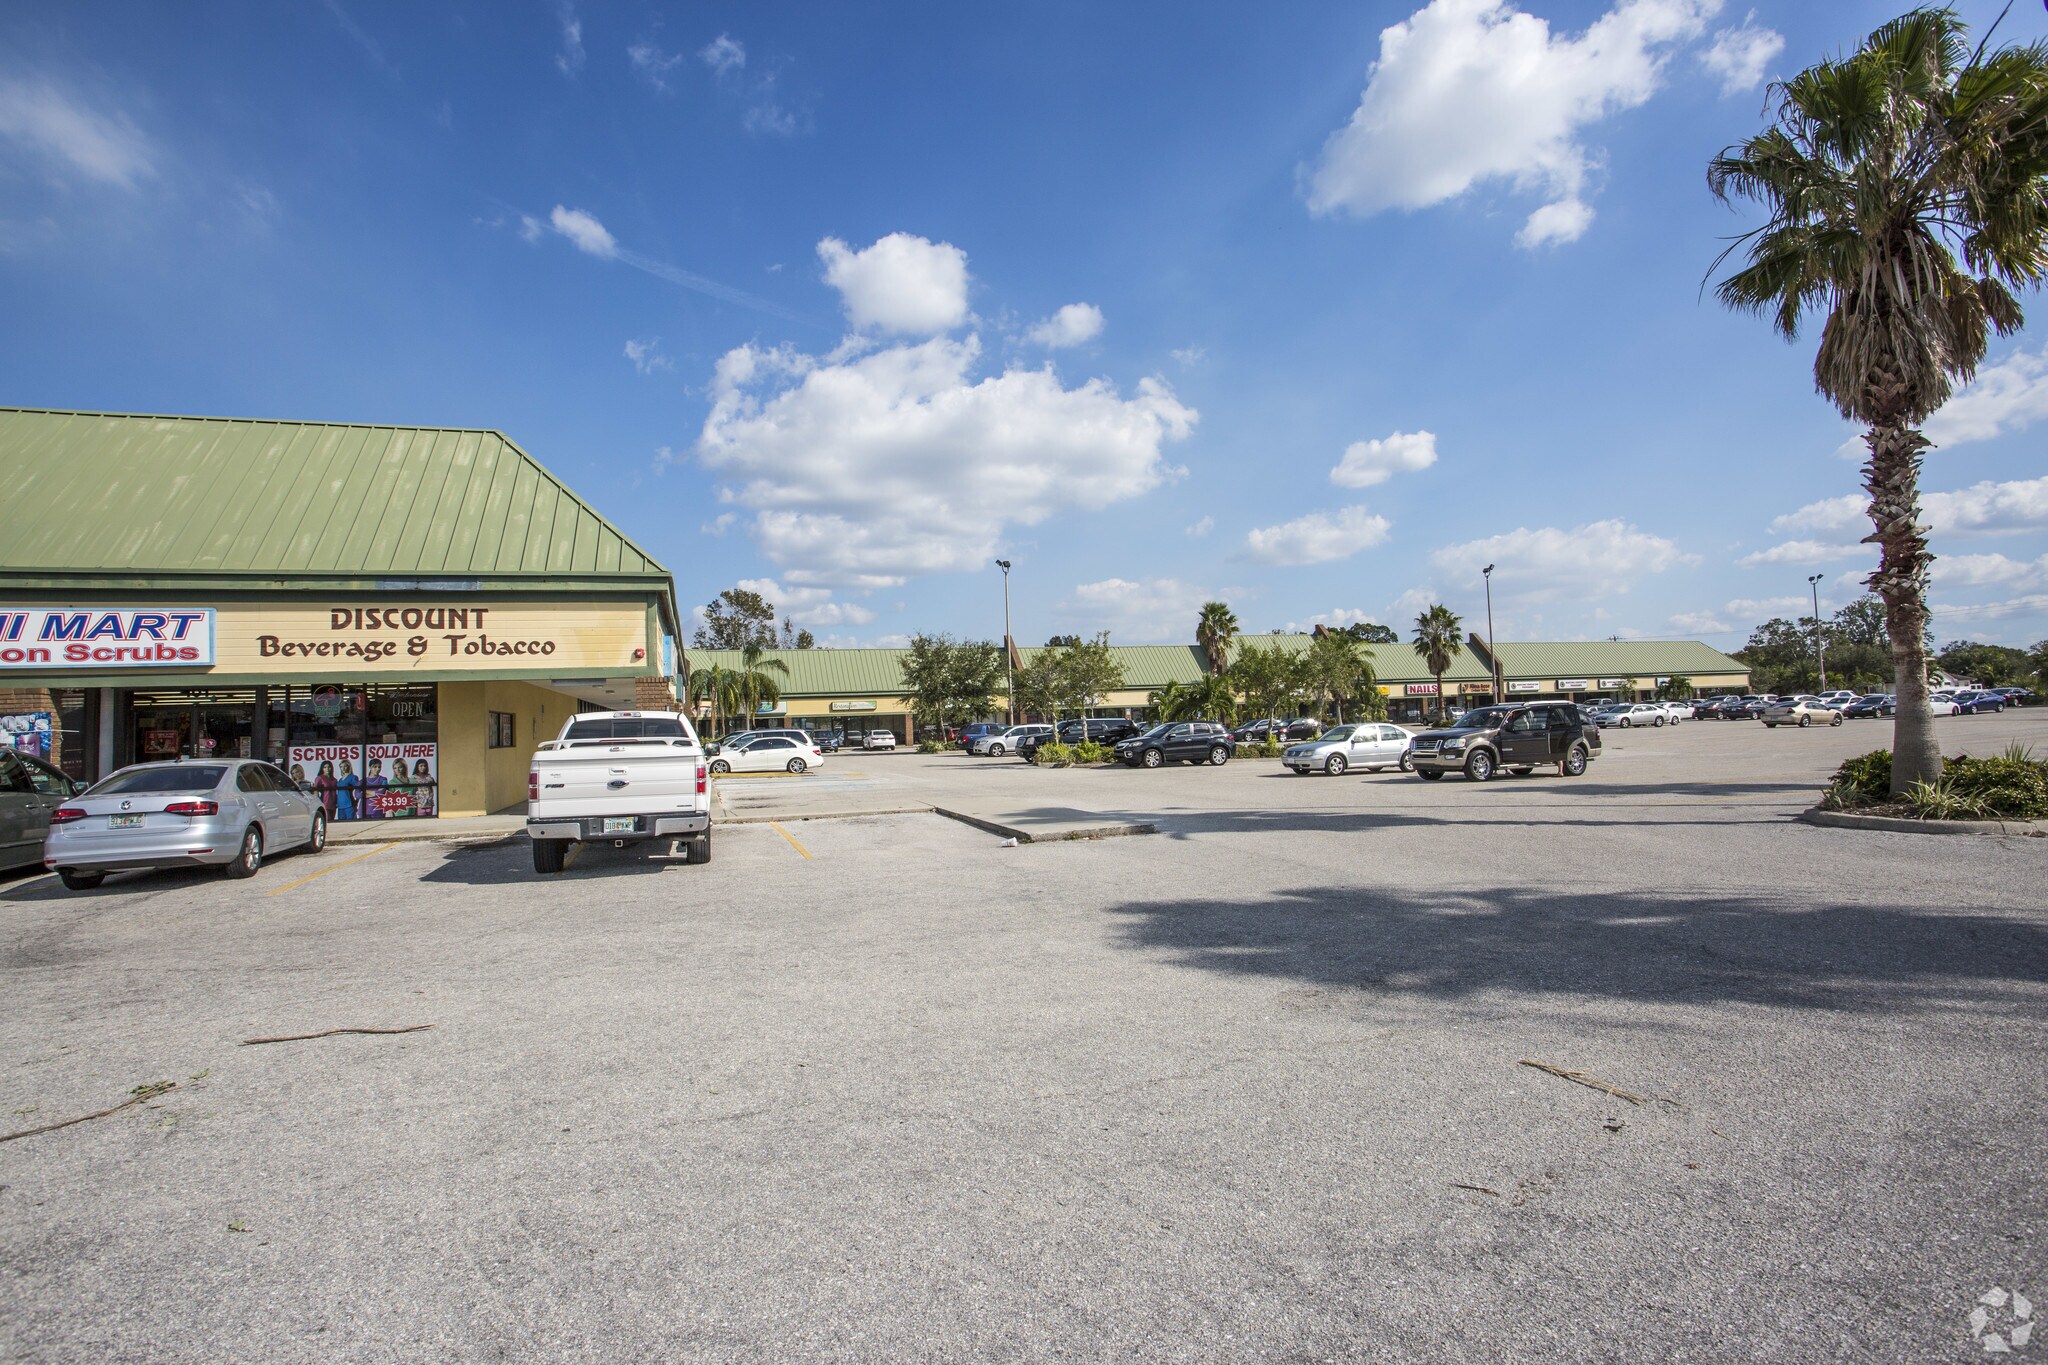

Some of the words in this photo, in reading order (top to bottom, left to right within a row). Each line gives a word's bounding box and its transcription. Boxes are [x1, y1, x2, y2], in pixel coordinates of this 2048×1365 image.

[37, 612, 205, 641] MART
[330, 608, 489, 630] DISCOUNT
[63, 643, 200, 662] Scrubs
[256, 635, 397, 662] Beverage
[407, 635, 428, 656] &
[443, 634, 556, 656] Tobacco
[1410, 684, 1439, 693] NAILS
[392, 702, 424, 717] OPEN
[293, 747, 360, 761] SCRUBS
[368, 746, 400, 759] SOLD
[402, 745, 435, 758] HERE
[381, 797, 408, 807] $3.99
